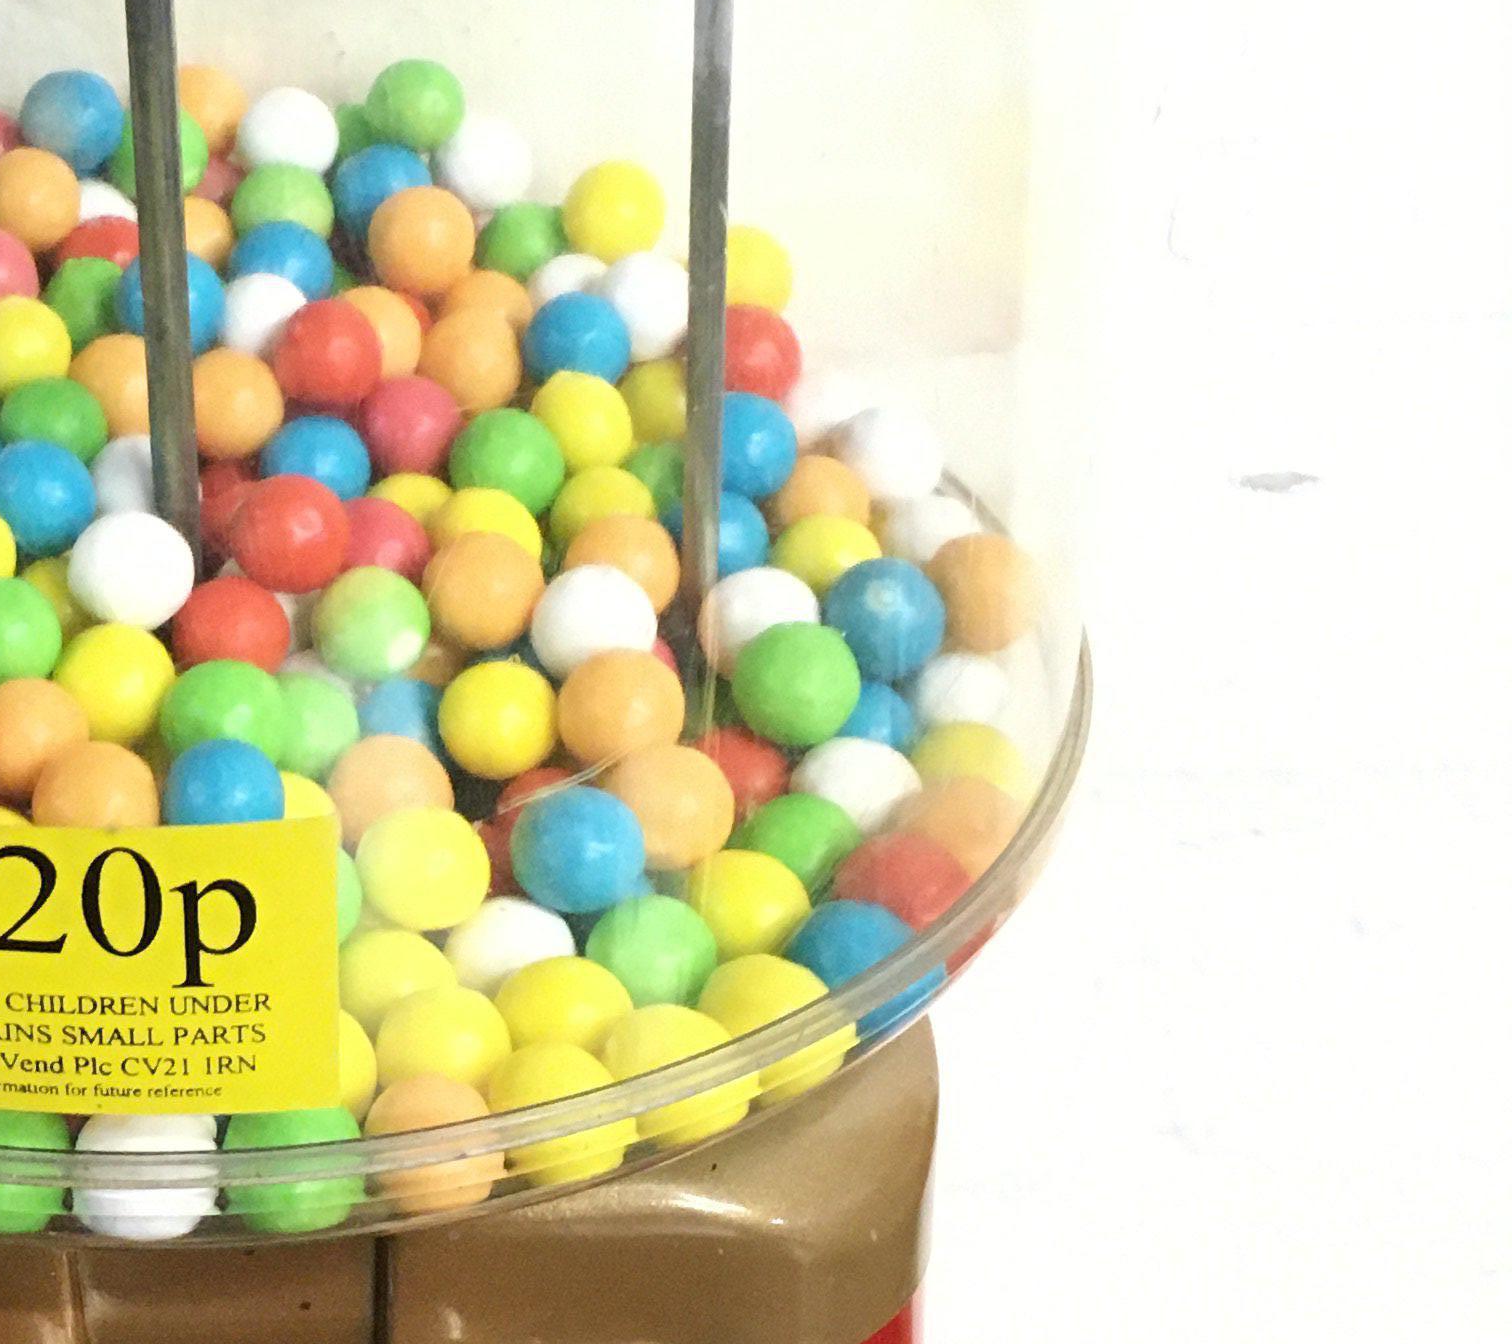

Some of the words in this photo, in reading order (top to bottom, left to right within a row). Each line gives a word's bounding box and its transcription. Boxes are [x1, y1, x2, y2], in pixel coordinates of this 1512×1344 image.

[5, 992, 159, 1016] CHILDREN
[170, 992, 271, 1016] UNDER
[61, 1024, 164, 1047] SMALL
[174, 1022, 267, 1045] PARTS
[120, 1057, 190, 1077] CV21
[64, 1082, 88, 1096] for
[93, 1083, 142, 1098] future
[146, 1084, 223, 1098] reference
